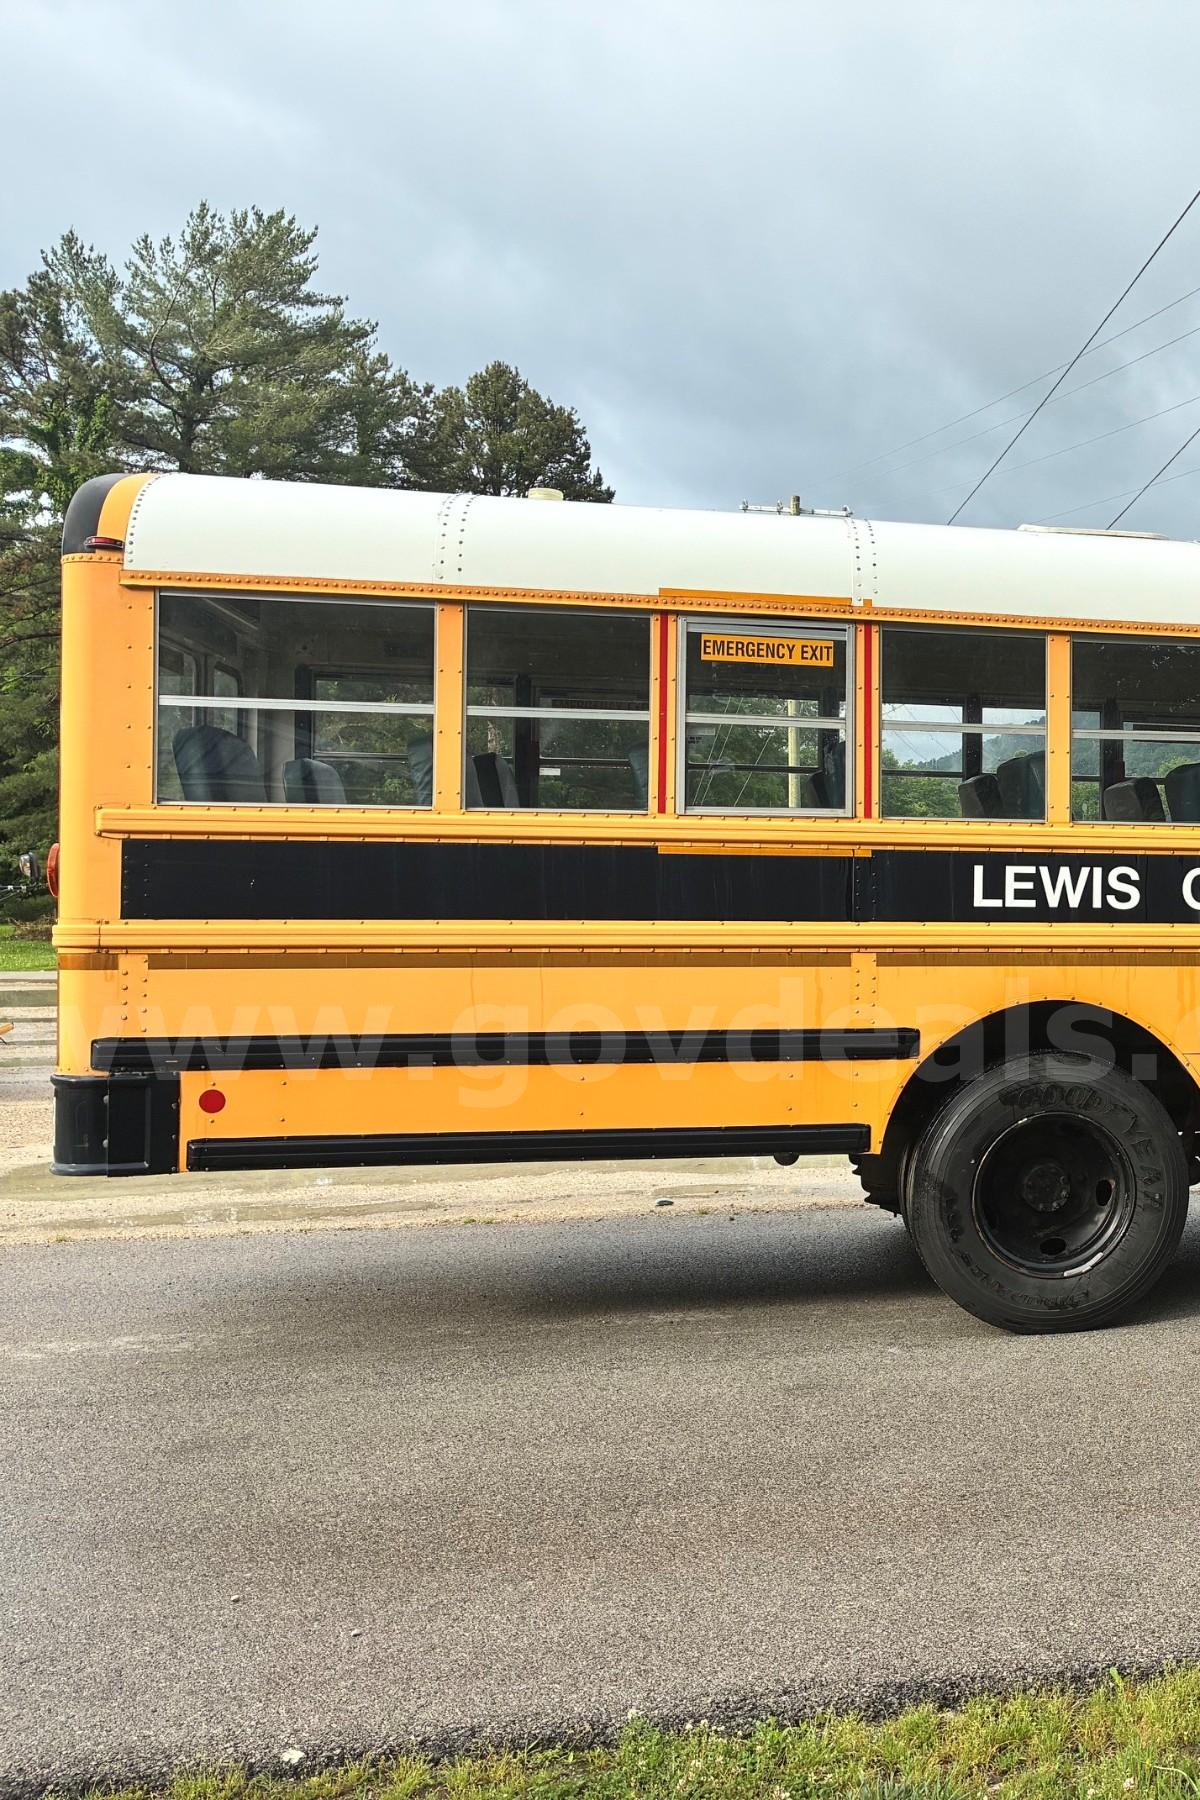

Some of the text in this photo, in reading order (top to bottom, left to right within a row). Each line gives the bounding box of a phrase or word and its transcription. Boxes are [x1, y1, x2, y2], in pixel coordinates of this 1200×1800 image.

[703, 639, 833, 662] EMERGENCY EXIT
[973, 865, 1141, 911] LEWIS
